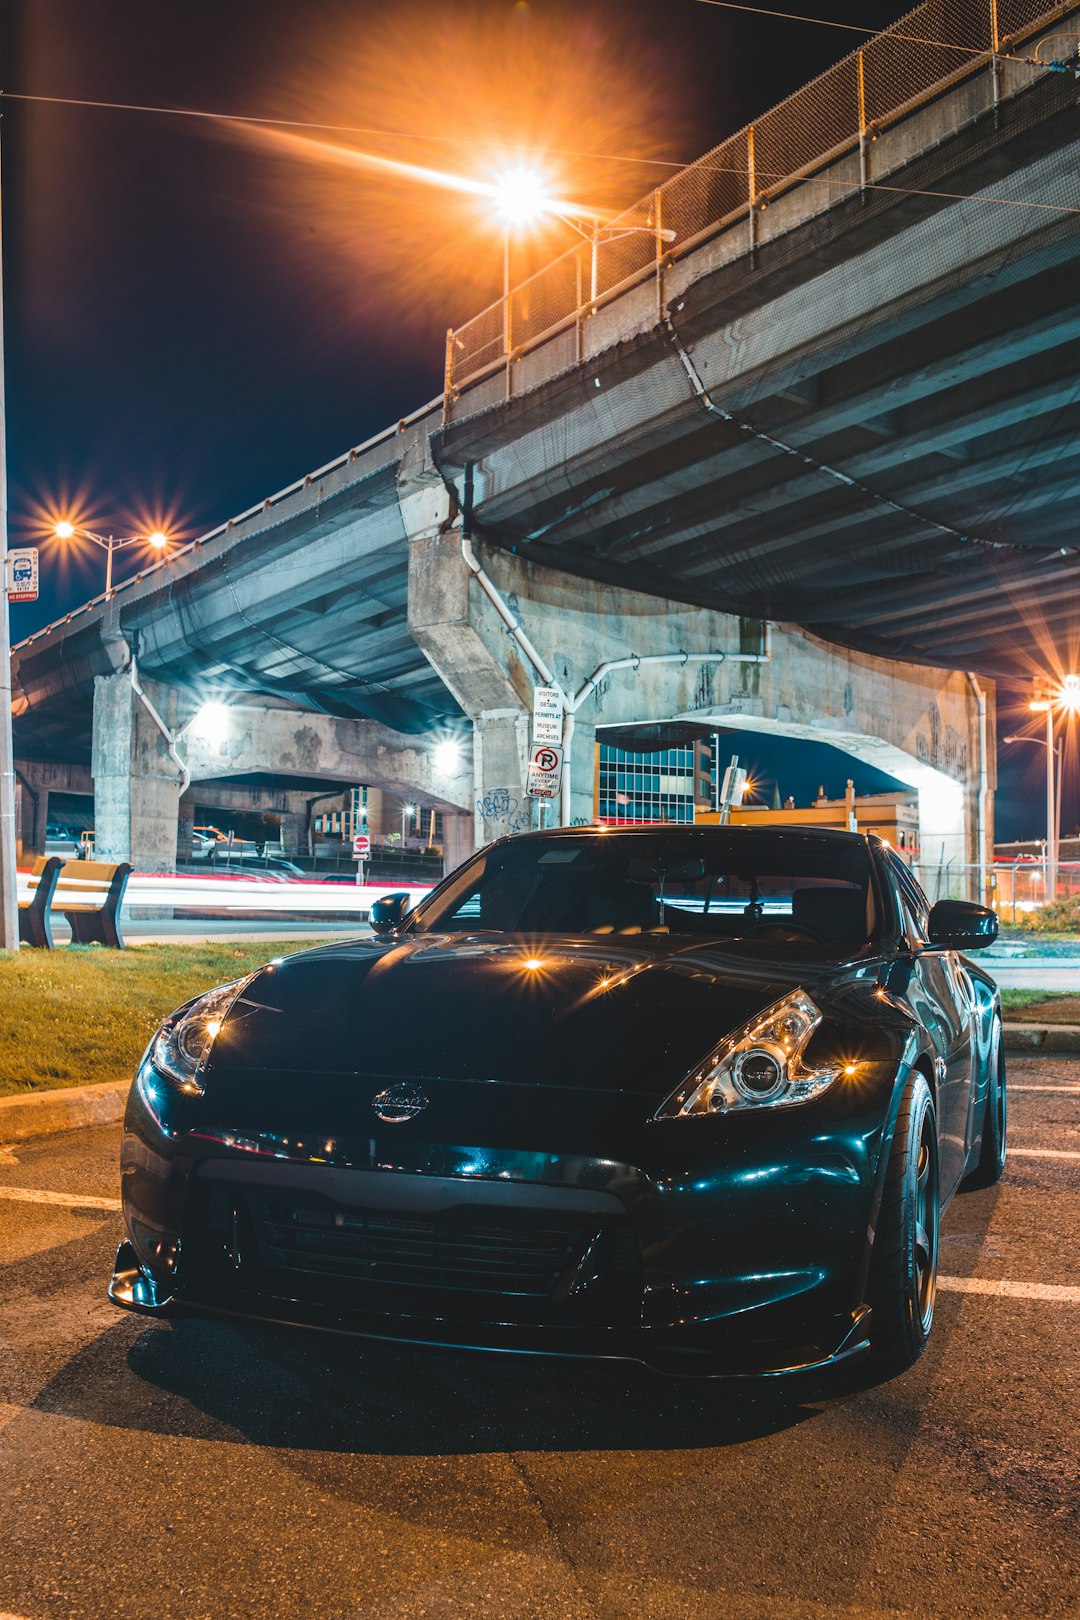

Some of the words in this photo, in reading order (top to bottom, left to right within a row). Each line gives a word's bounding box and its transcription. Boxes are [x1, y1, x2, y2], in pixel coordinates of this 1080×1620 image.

[538, 690, 559, 698] VISITORS
[535, 711, 555, 719] PERMITS
[537, 722, 557, 730] MUSEUM
[537, 733, 559, 741] ARCHIVES
[531, 772, 559, 780] ANYTIME
